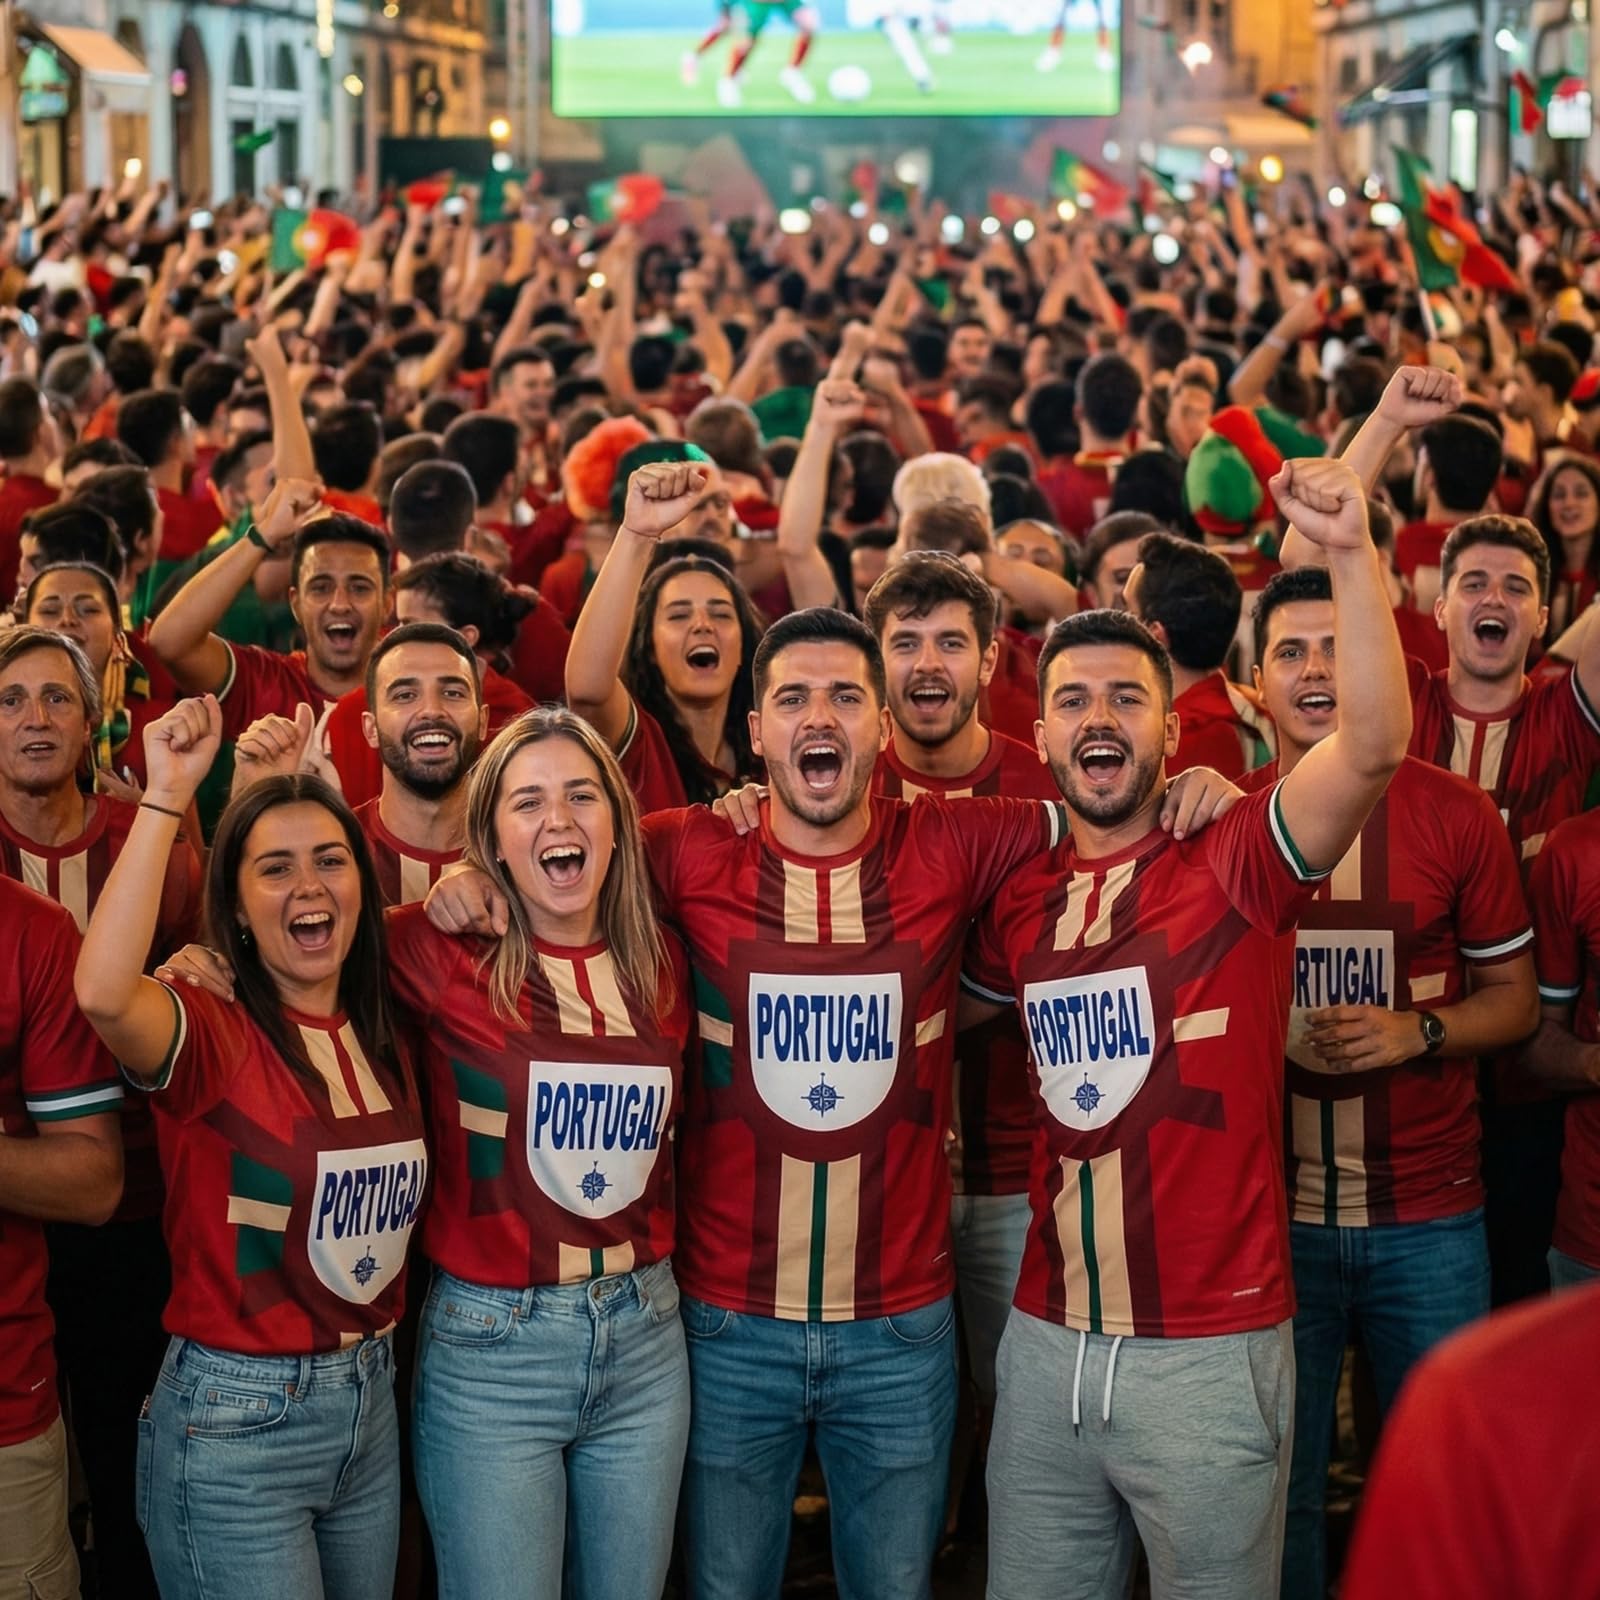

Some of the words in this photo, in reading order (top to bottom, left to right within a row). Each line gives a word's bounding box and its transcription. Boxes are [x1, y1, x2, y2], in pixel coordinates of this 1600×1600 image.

[1295, 946, 1388, 1008] RTUGAL
[756, 993, 894, 1063] PORTUGAL
[1027, 987, 1151, 1067] PORTUGAL
[533, 1081, 666, 1151] PORTUGAL
